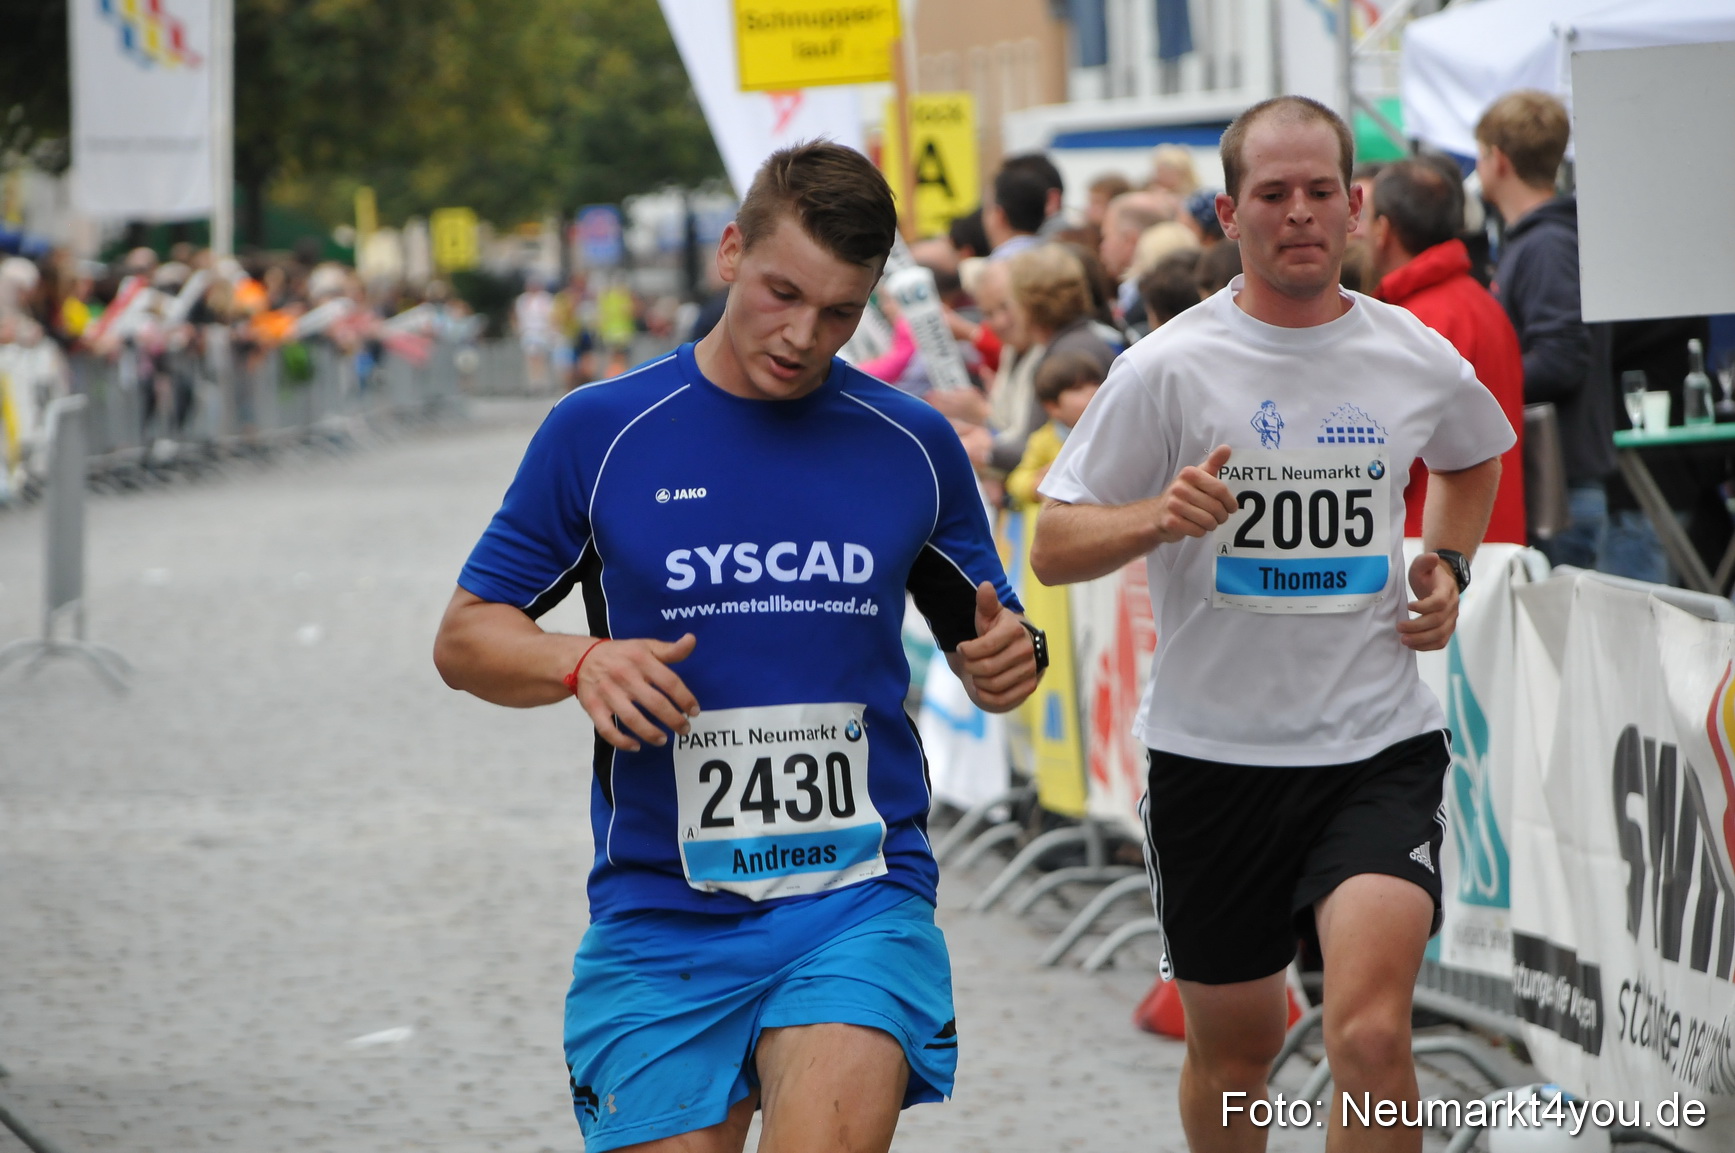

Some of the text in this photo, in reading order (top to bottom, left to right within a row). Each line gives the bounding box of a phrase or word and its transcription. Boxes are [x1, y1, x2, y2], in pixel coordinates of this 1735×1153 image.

[747, 5, 885, 30] Schnupper-
[792, 37, 842, 58] lauf
[911, 138, 956, 199] A
[1218, 464, 1361, 481] PARTL Neumarkt
[673, 487, 707, 500] JAKO
[1233, 488, 1374, 550] 2005
[1220, 544, 1229, 555] A
[665, 541, 874, 591] SYSCAD
[1258, 566, 1347, 591] Thomas
[661, 595, 879, 620] www.metallbau-cad.de
[678, 723, 838, 750] PARTL Neumarkt
[698, 751, 856, 829] 2430
[686, 827, 695, 839] A
[732, 843, 837, 874] Andreas
